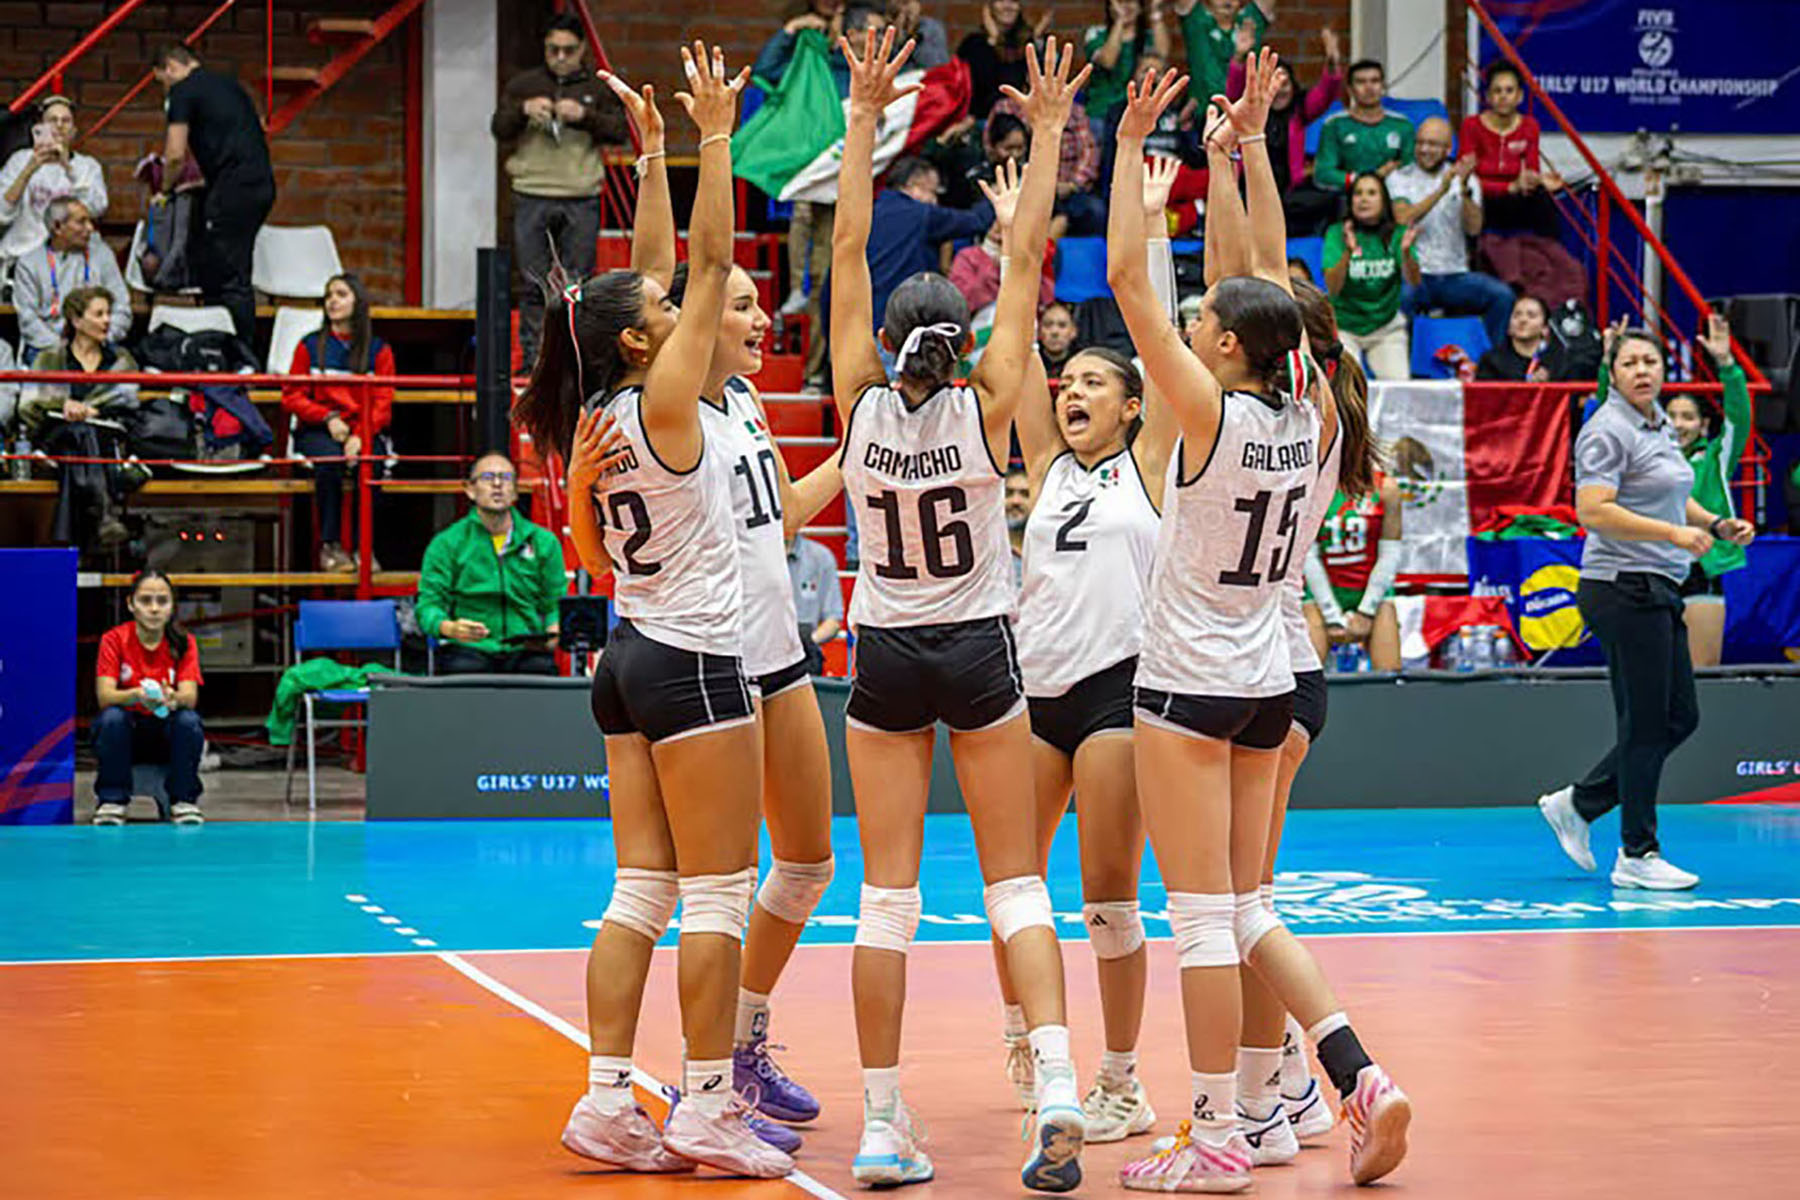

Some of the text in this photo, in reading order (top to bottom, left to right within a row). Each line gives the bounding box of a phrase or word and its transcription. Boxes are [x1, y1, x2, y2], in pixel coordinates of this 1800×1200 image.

[1580, 76, 1609, 94] U17
[1613, 77, 1667, 95] WORLD
[1669, 78, 1779, 97] CHAMPIONSHIP
[863, 442, 961, 480] CAMACHO
[734, 449, 782, 529] 10
[866, 486, 974, 580] 16
[1055, 497, 1096, 552] 2
[1218, 484, 1307, 588] 15
[1323, 515, 1368, 553] 13
[476, 774, 538, 791] GIRLS'
[541, 774, 577, 790] U17
[1736, 760, 1790, 776] GIRLS'
